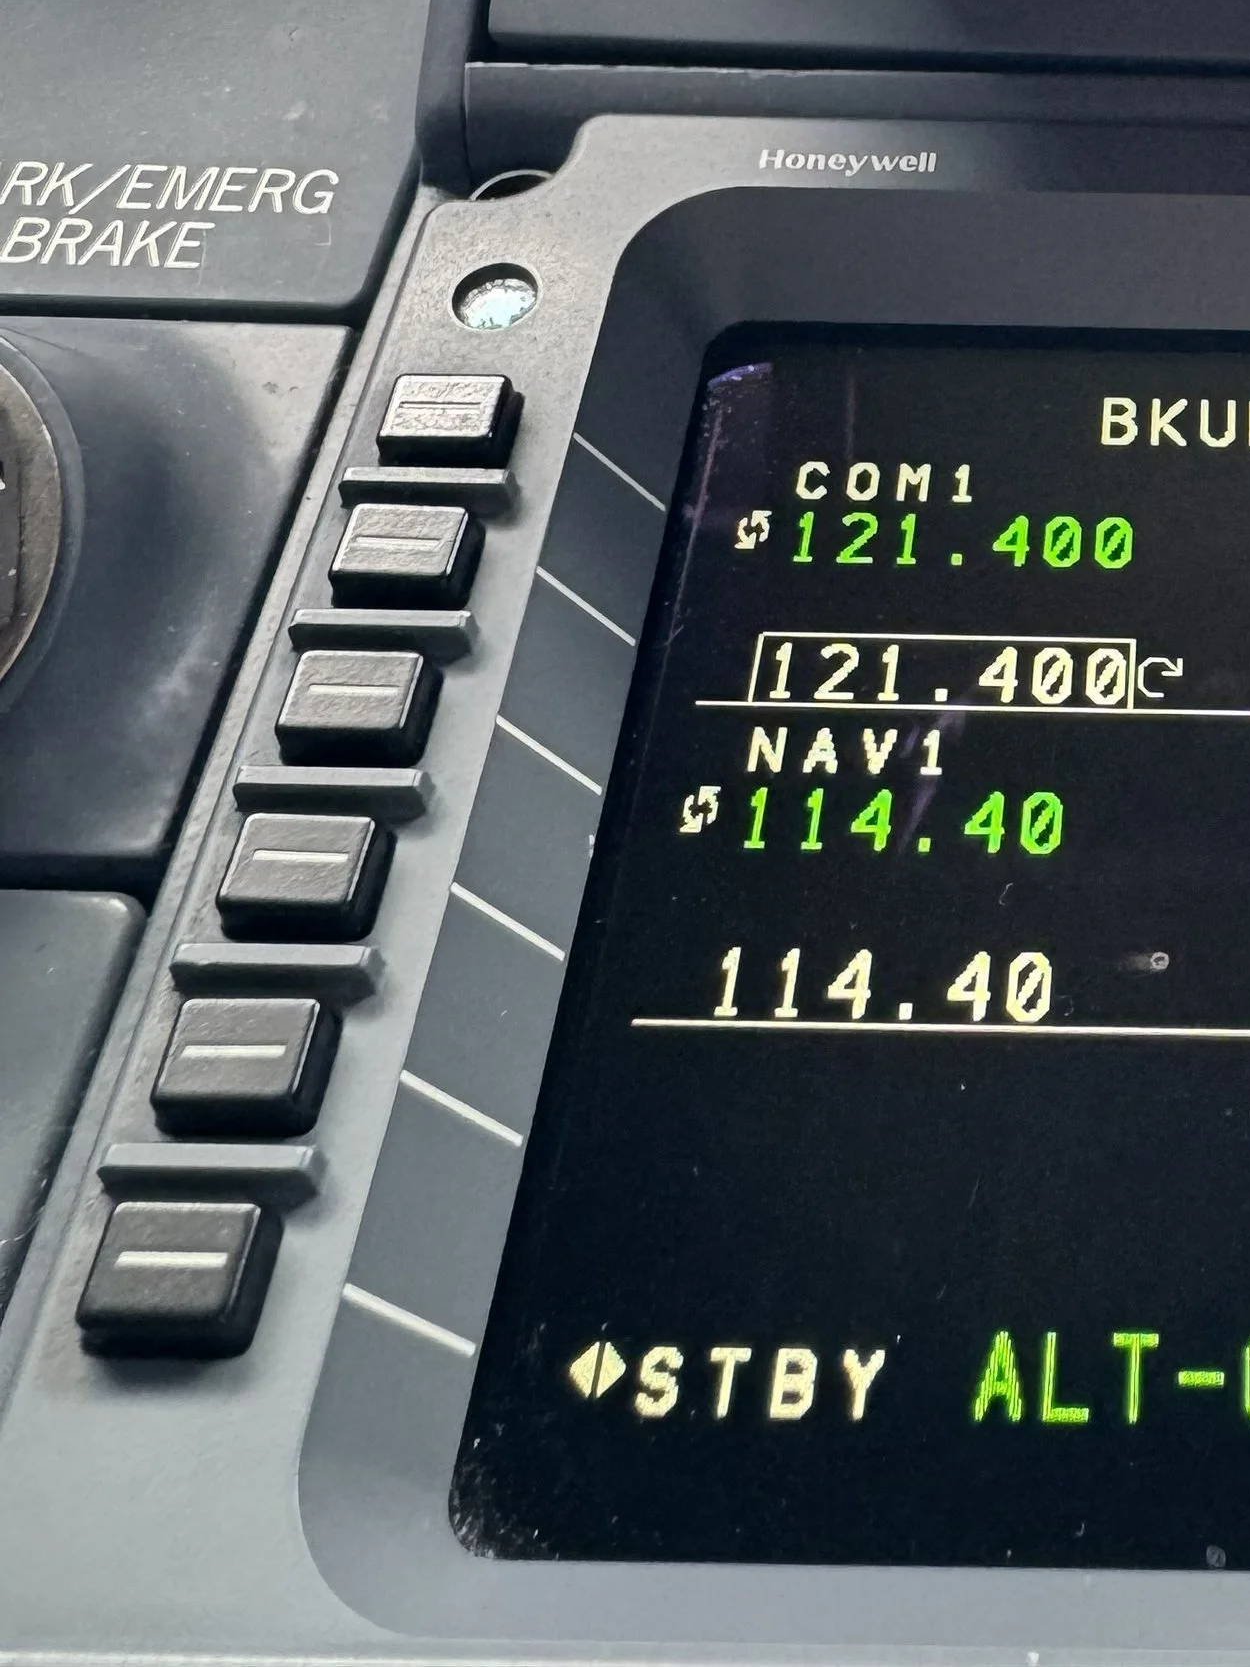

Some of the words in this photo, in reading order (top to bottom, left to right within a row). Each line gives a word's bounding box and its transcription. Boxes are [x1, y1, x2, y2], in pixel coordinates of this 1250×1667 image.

[0, 161, 340, 216] RK/EMERG
[757, 148, 938, 177] Honeywell
[0, 216, 216, 270] BRAKE
[795, 460, 974, 504] COM1
[792, 510, 1134, 571] 121.400
[767, 641, 1128, 706] 121.400
[747, 725, 944, 776] NAV1
[743, 786, 1065, 856] 114.40
[713, 946, 1053, 1024] 114.40
[634, 1345, 887, 1421] STBY
